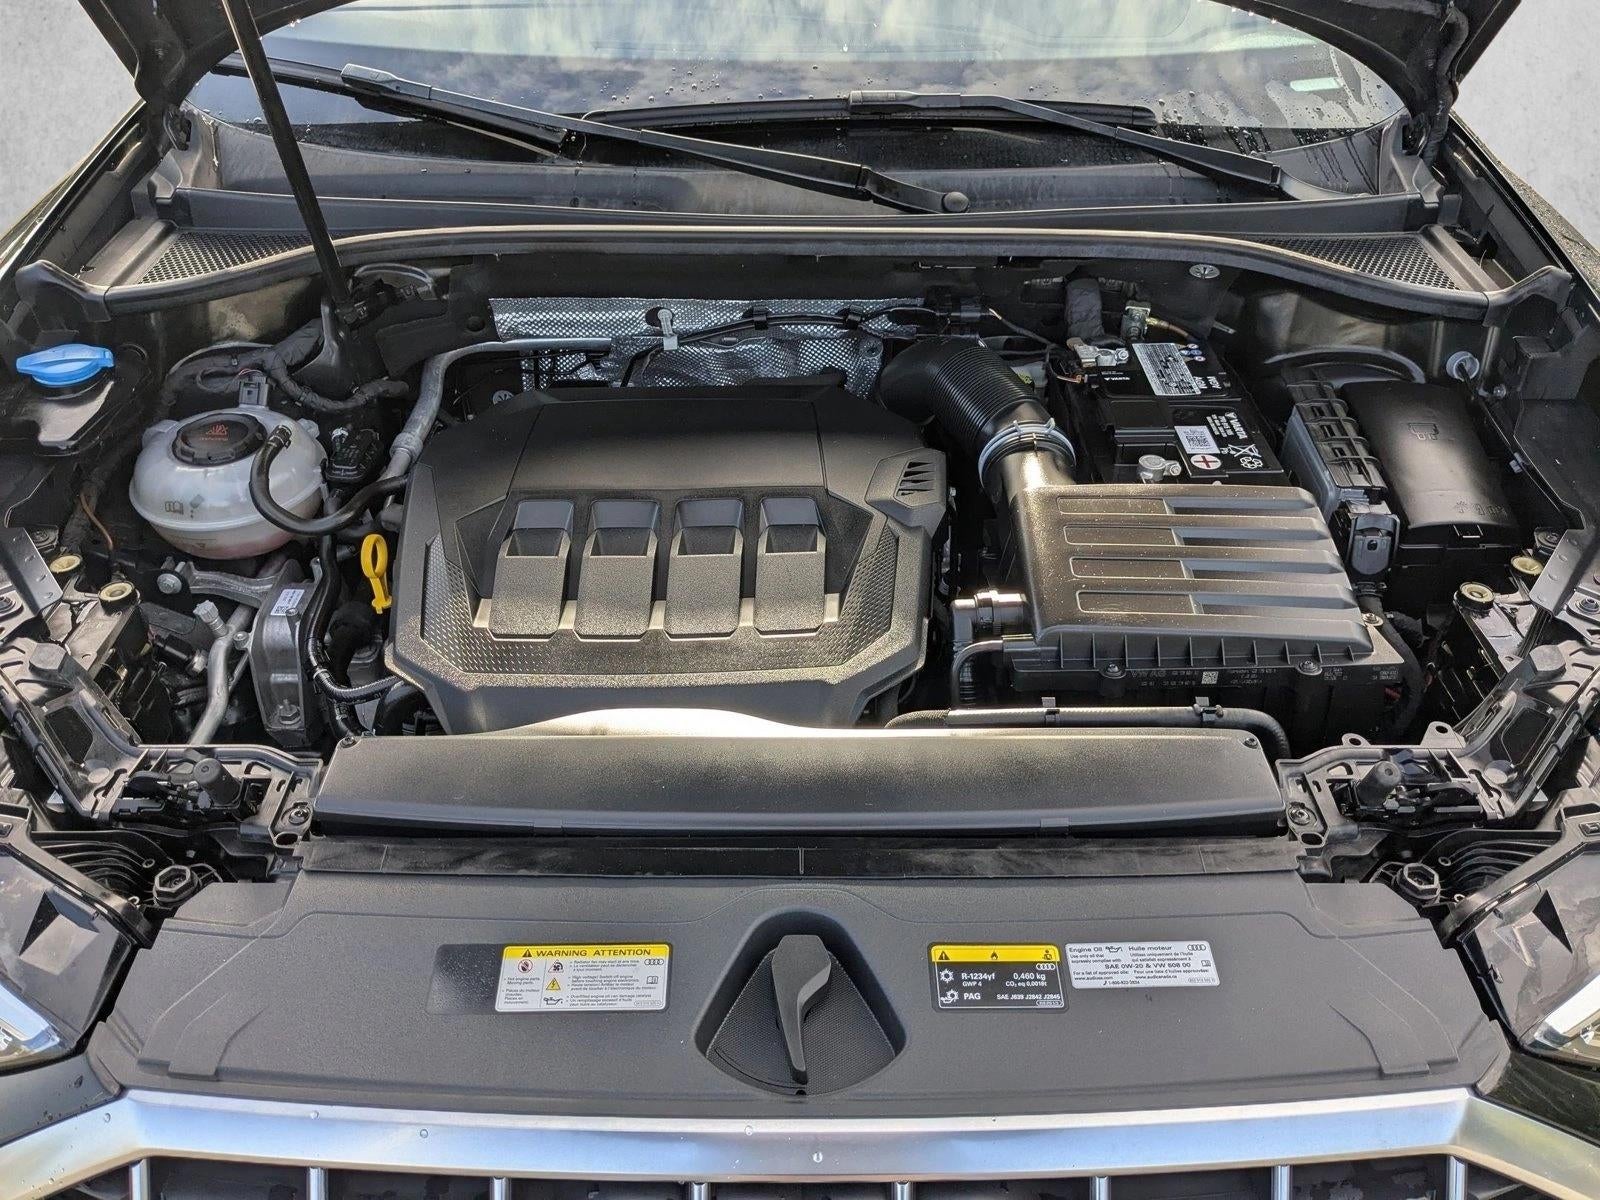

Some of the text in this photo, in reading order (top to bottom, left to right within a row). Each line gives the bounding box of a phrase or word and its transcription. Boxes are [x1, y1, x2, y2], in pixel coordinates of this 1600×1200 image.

[1230, 418, 1248, 440] VARTA
[593, 948, 651, 956] ATTENTION
[962, 972, 996, 980] R-1234yf
[1036, 972, 1046, 981] kg
